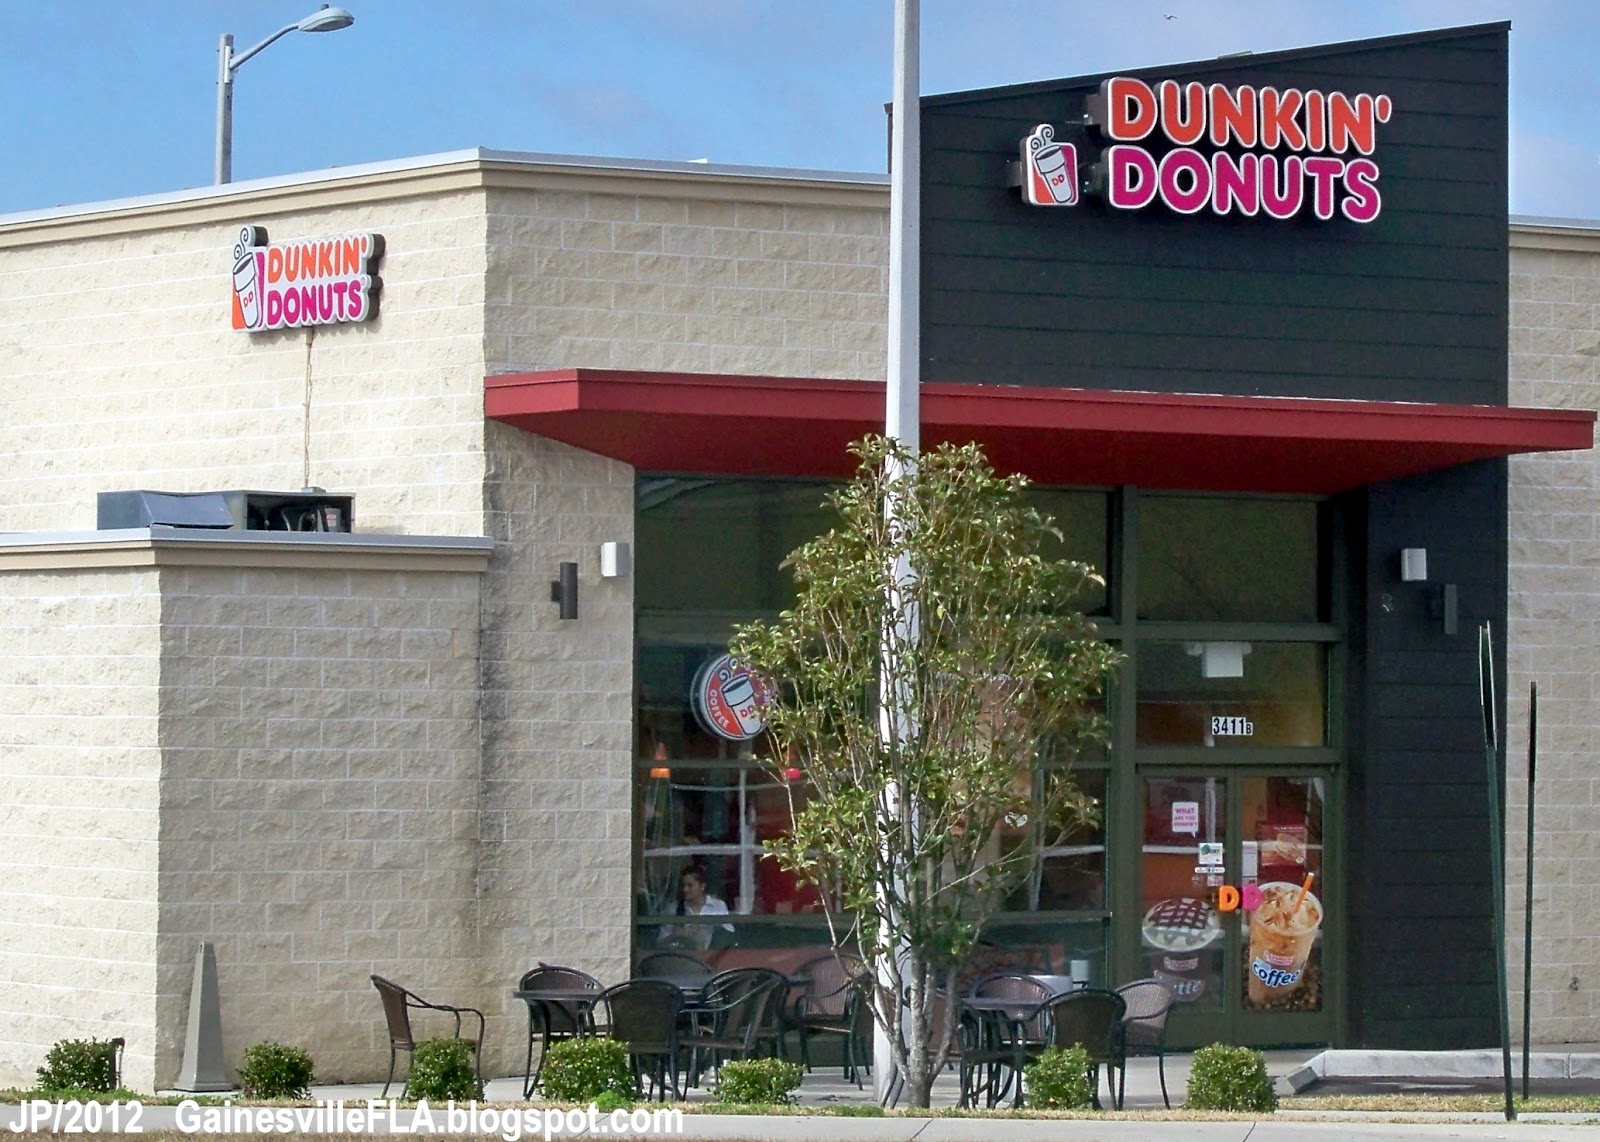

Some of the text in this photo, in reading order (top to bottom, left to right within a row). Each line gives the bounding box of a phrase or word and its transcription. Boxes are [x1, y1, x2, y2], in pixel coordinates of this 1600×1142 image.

[1108, 76, 1392, 155] DUNKIN'
[1108, 144, 1381, 223] DONUTS
[267, 236, 367, 284] DUNKIN'
[243, 291, 254, 308] DD
[267, 279, 362, 326] DONUTS
